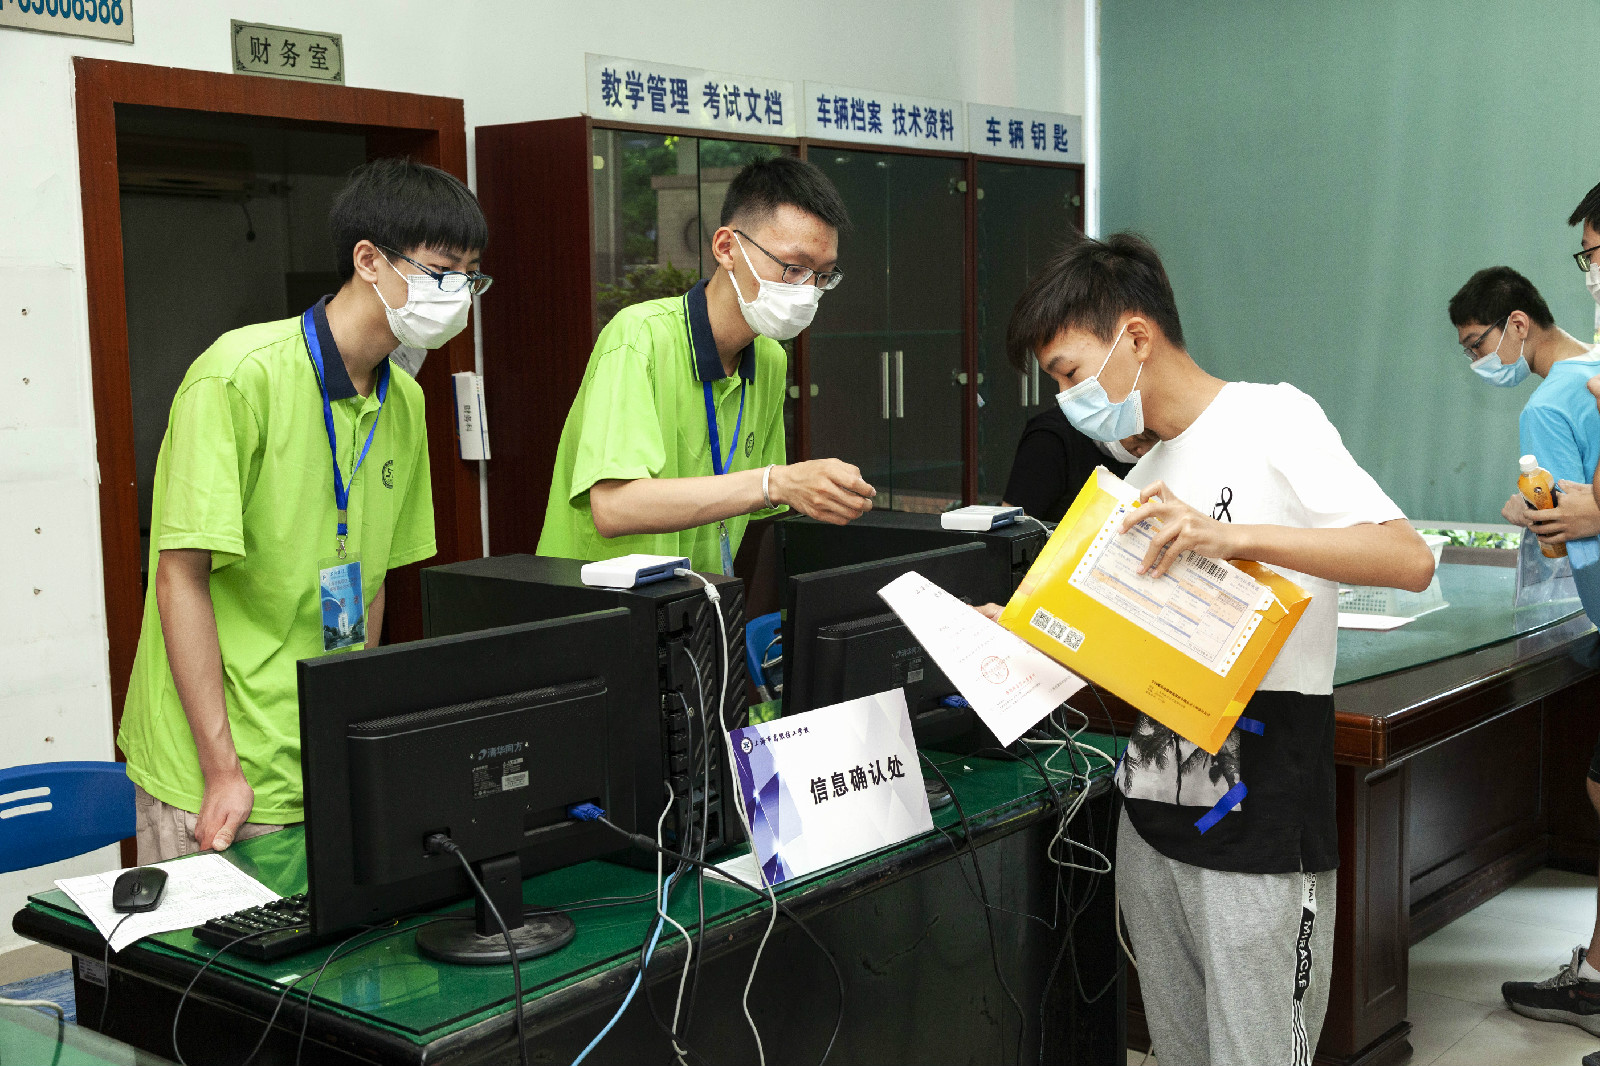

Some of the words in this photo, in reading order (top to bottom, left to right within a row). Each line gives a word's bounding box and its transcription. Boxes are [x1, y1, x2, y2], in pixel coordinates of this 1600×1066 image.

[249, 36, 330, 71] 财务室
[601, 67, 690, 115] 教学管理
[702, 81, 783, 126] 考试文档
[816, 94, 882, 134] 车辆档案
[891, 103, 954, 141] 技术资料
[985, 116, 1069, 152] 车辆钥匙
[810, 755, 905, 805] 信息确认处
[1298, 920, 1312, 988] MIRACLE
